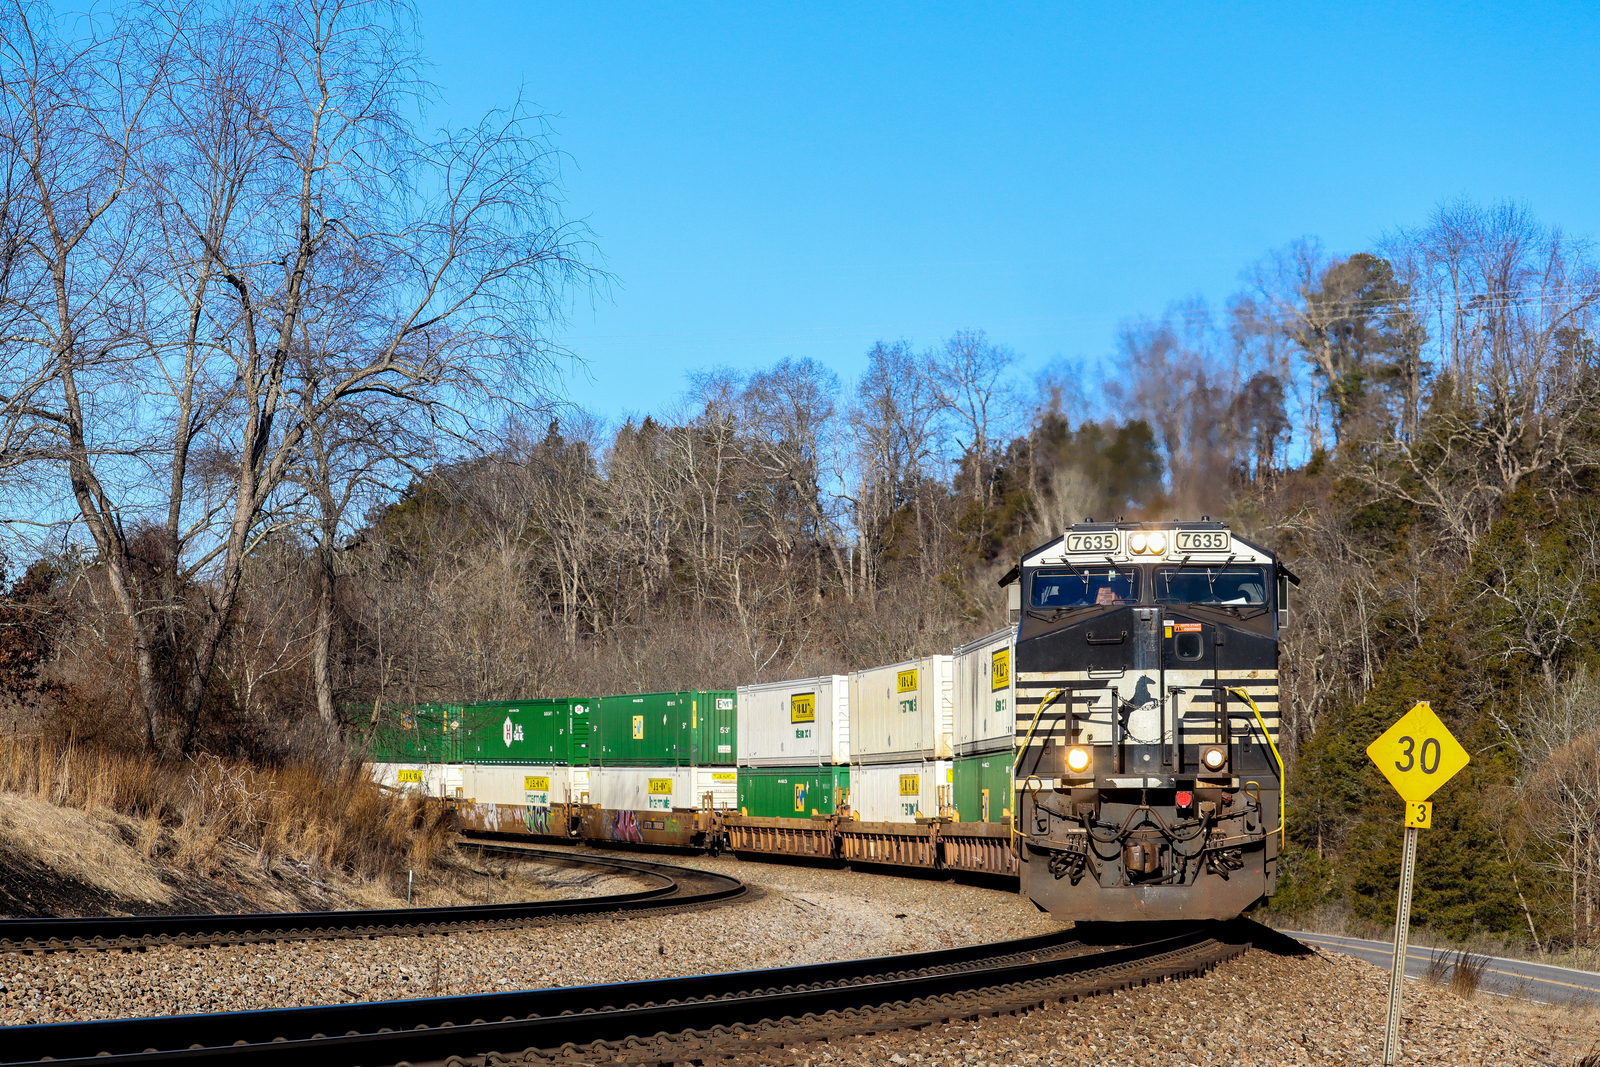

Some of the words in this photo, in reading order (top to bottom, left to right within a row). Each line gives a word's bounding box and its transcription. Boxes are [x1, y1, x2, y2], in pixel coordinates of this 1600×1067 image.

[1072, 535, 1113, 550] 7635
[1181, 533, 1222, 548] 7635
[1395, 735, 1441, 774] 30
[1416, 804, 1426, 822] 3
